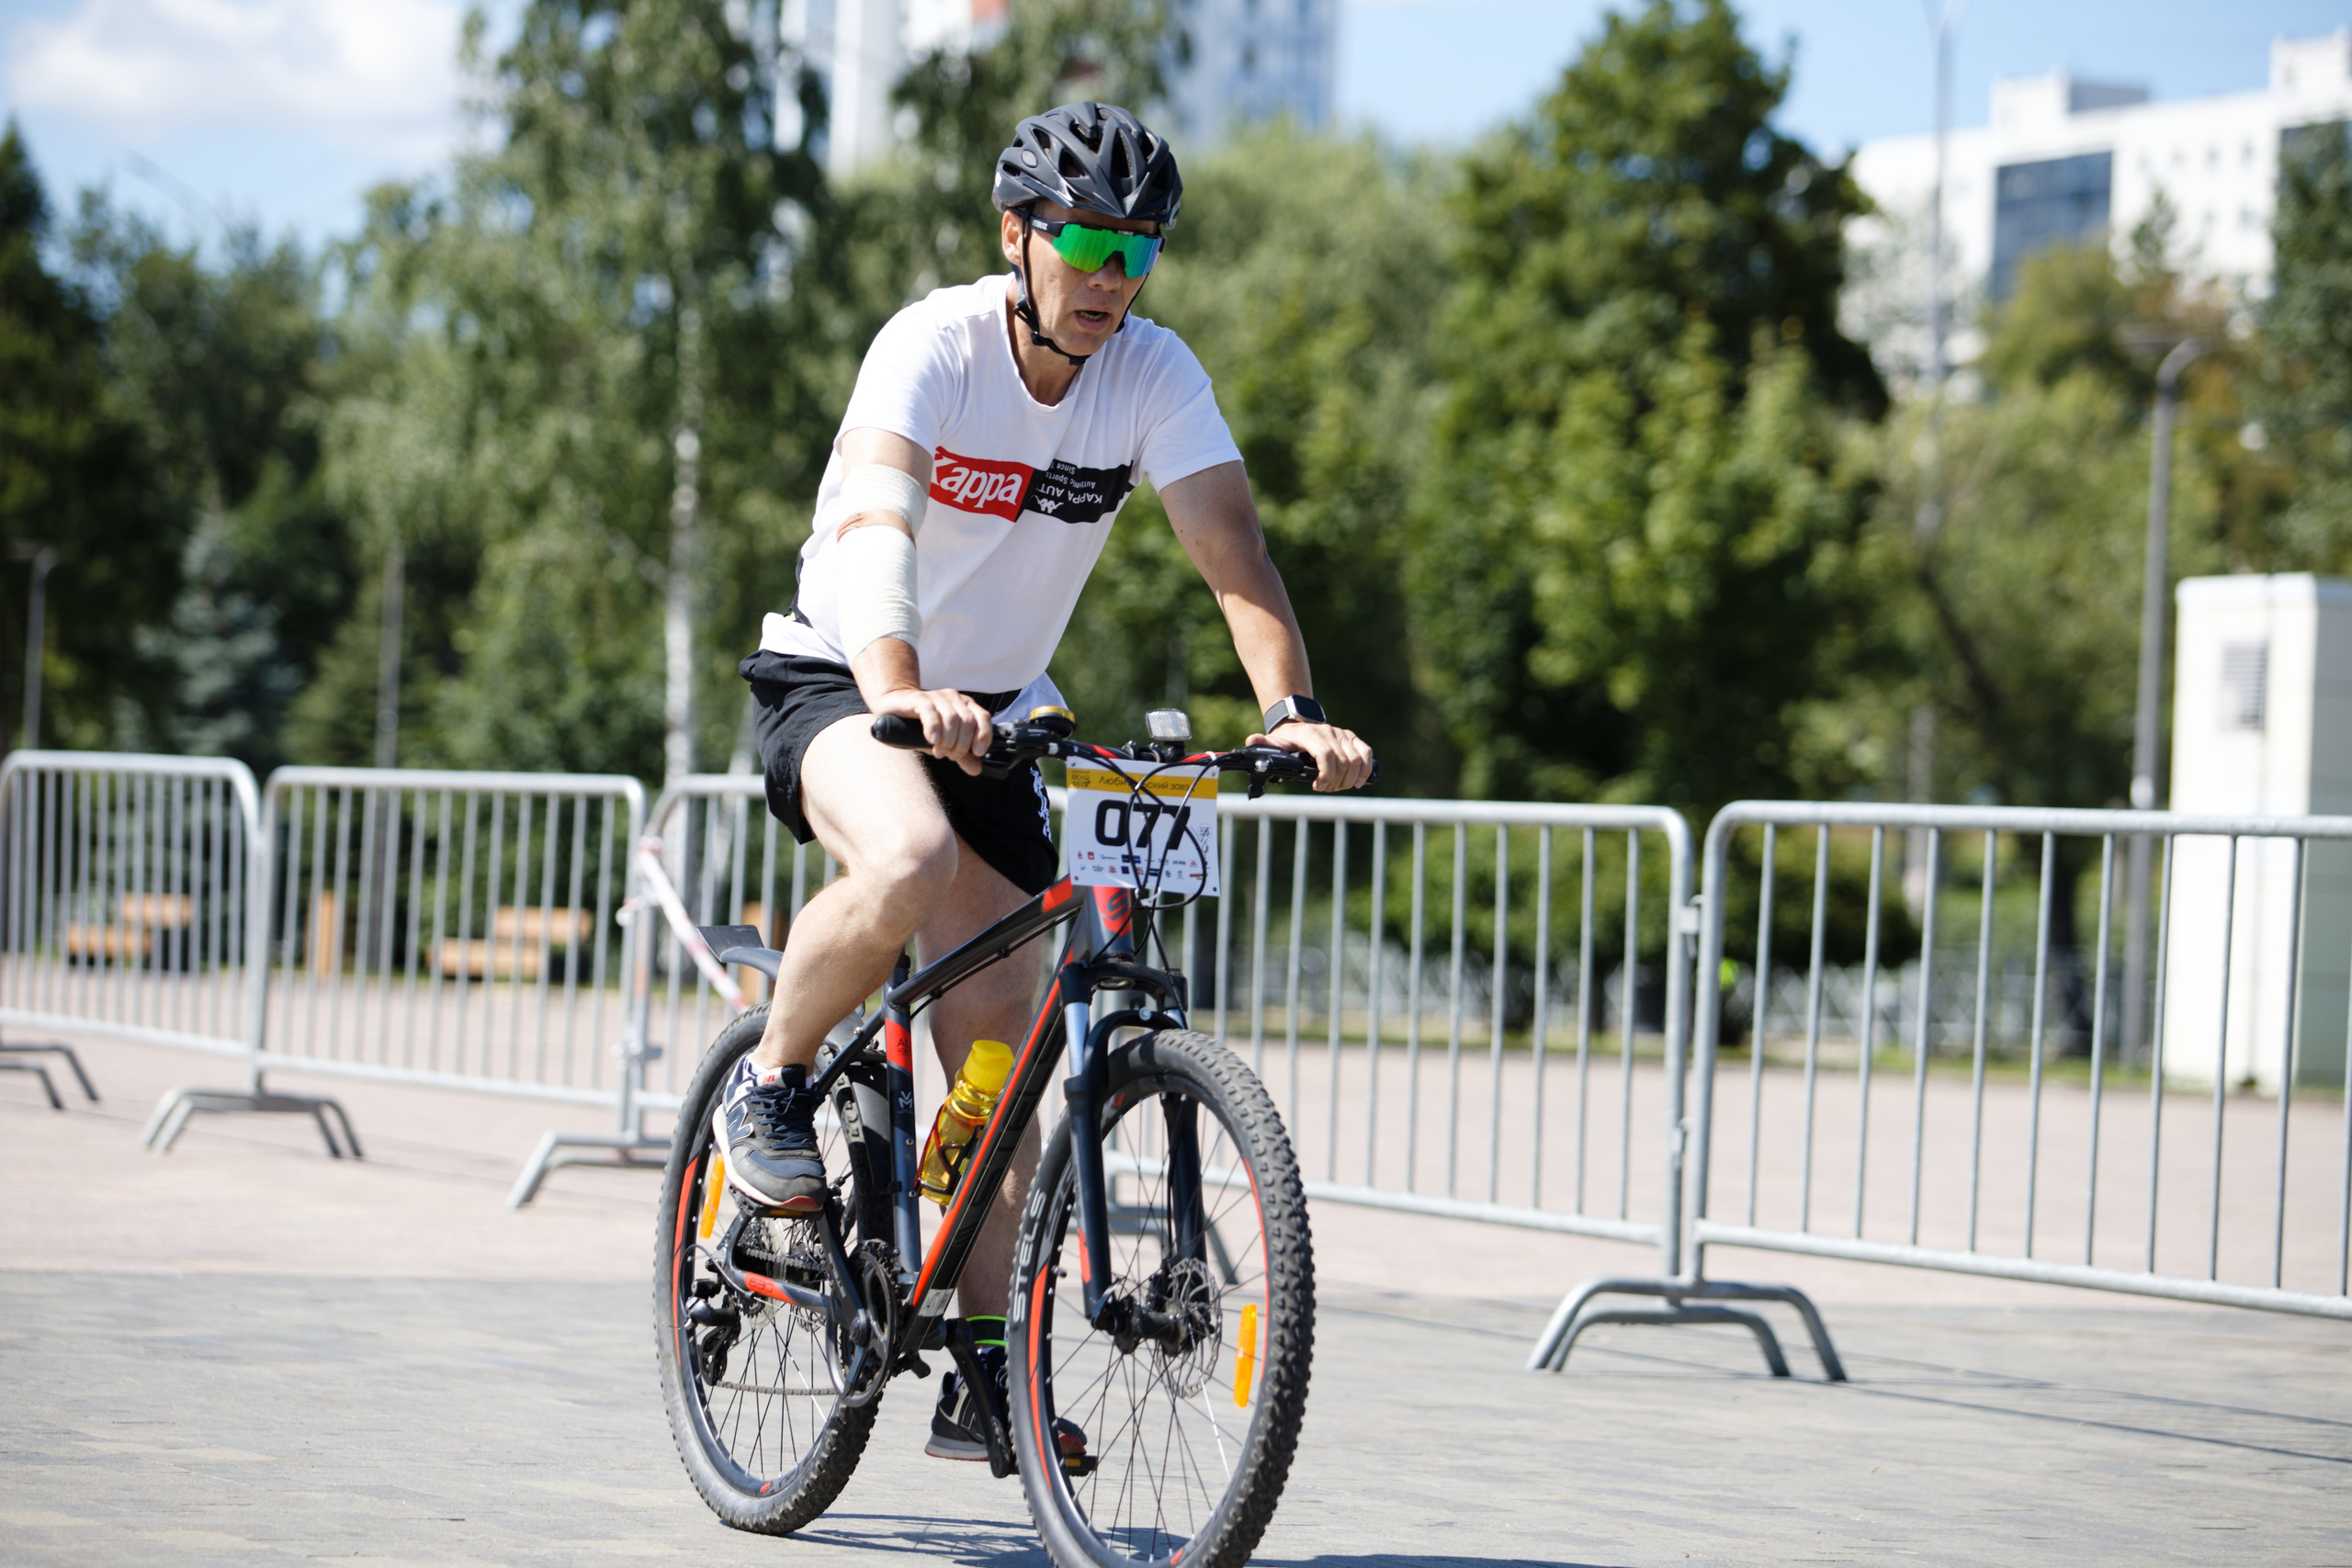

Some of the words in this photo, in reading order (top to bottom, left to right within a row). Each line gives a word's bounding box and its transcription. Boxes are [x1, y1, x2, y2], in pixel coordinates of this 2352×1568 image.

[1057, 461, 1076, 474] Since
[932, 456, 1023, 508] Kappa
[1046, 472, 1069, 483] Sports
[1036, 483, 1065, 497] AUT
[1068, 491, 1102, 504] KAPPA
[1099, 776, 1168, 790] Любиьский
[1170, 783, 1194, 793] заез
[1095, 799, 1191, 850] 077
[1012, 1188, 1047, 1324] STELS
[750, 1278, 775, 1293] 630
